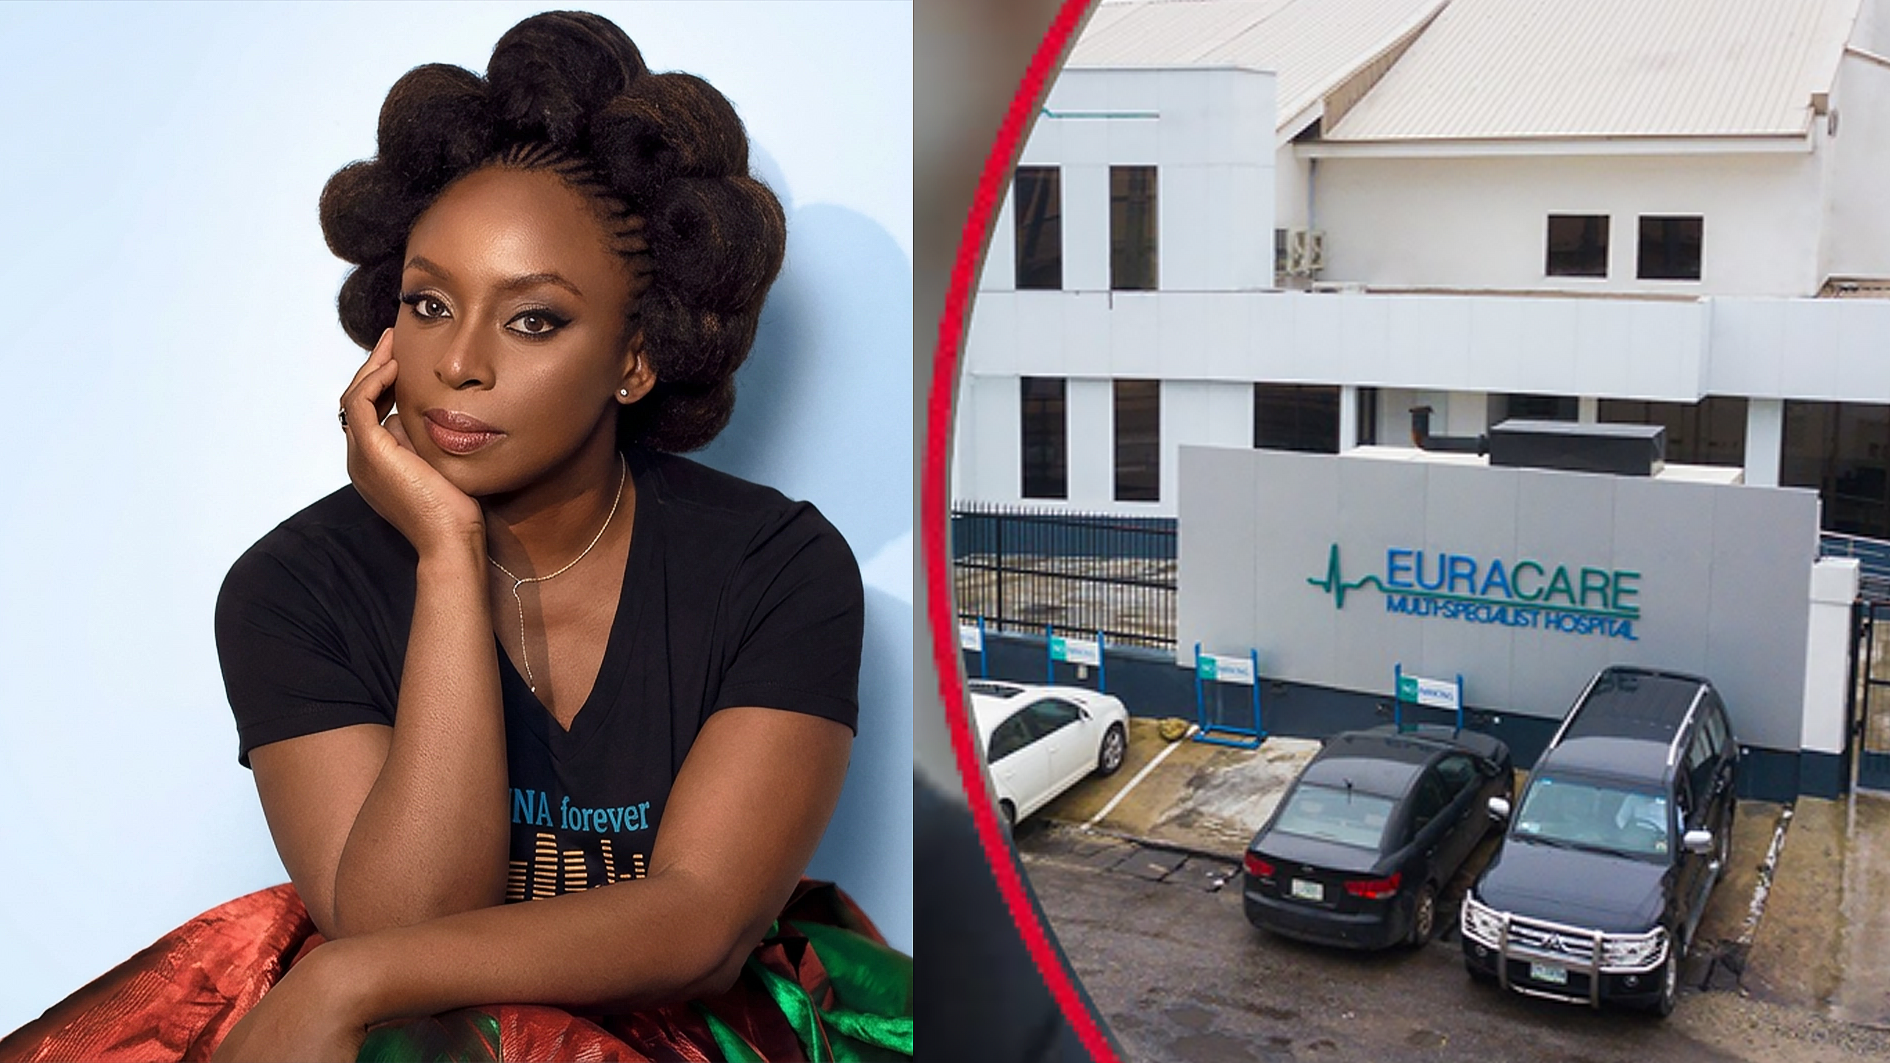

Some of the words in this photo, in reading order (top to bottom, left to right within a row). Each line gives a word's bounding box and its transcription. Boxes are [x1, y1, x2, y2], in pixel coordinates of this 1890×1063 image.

[1386, 547, 1642, 614] EURACARE
[1386, 594, 1541, 629] MULTI-SPECIALIST
[1544, 610, 1640, 641] HOSPITAL
[509, 787, 554, 827] NA
[560, 795, 650, 833] forever
